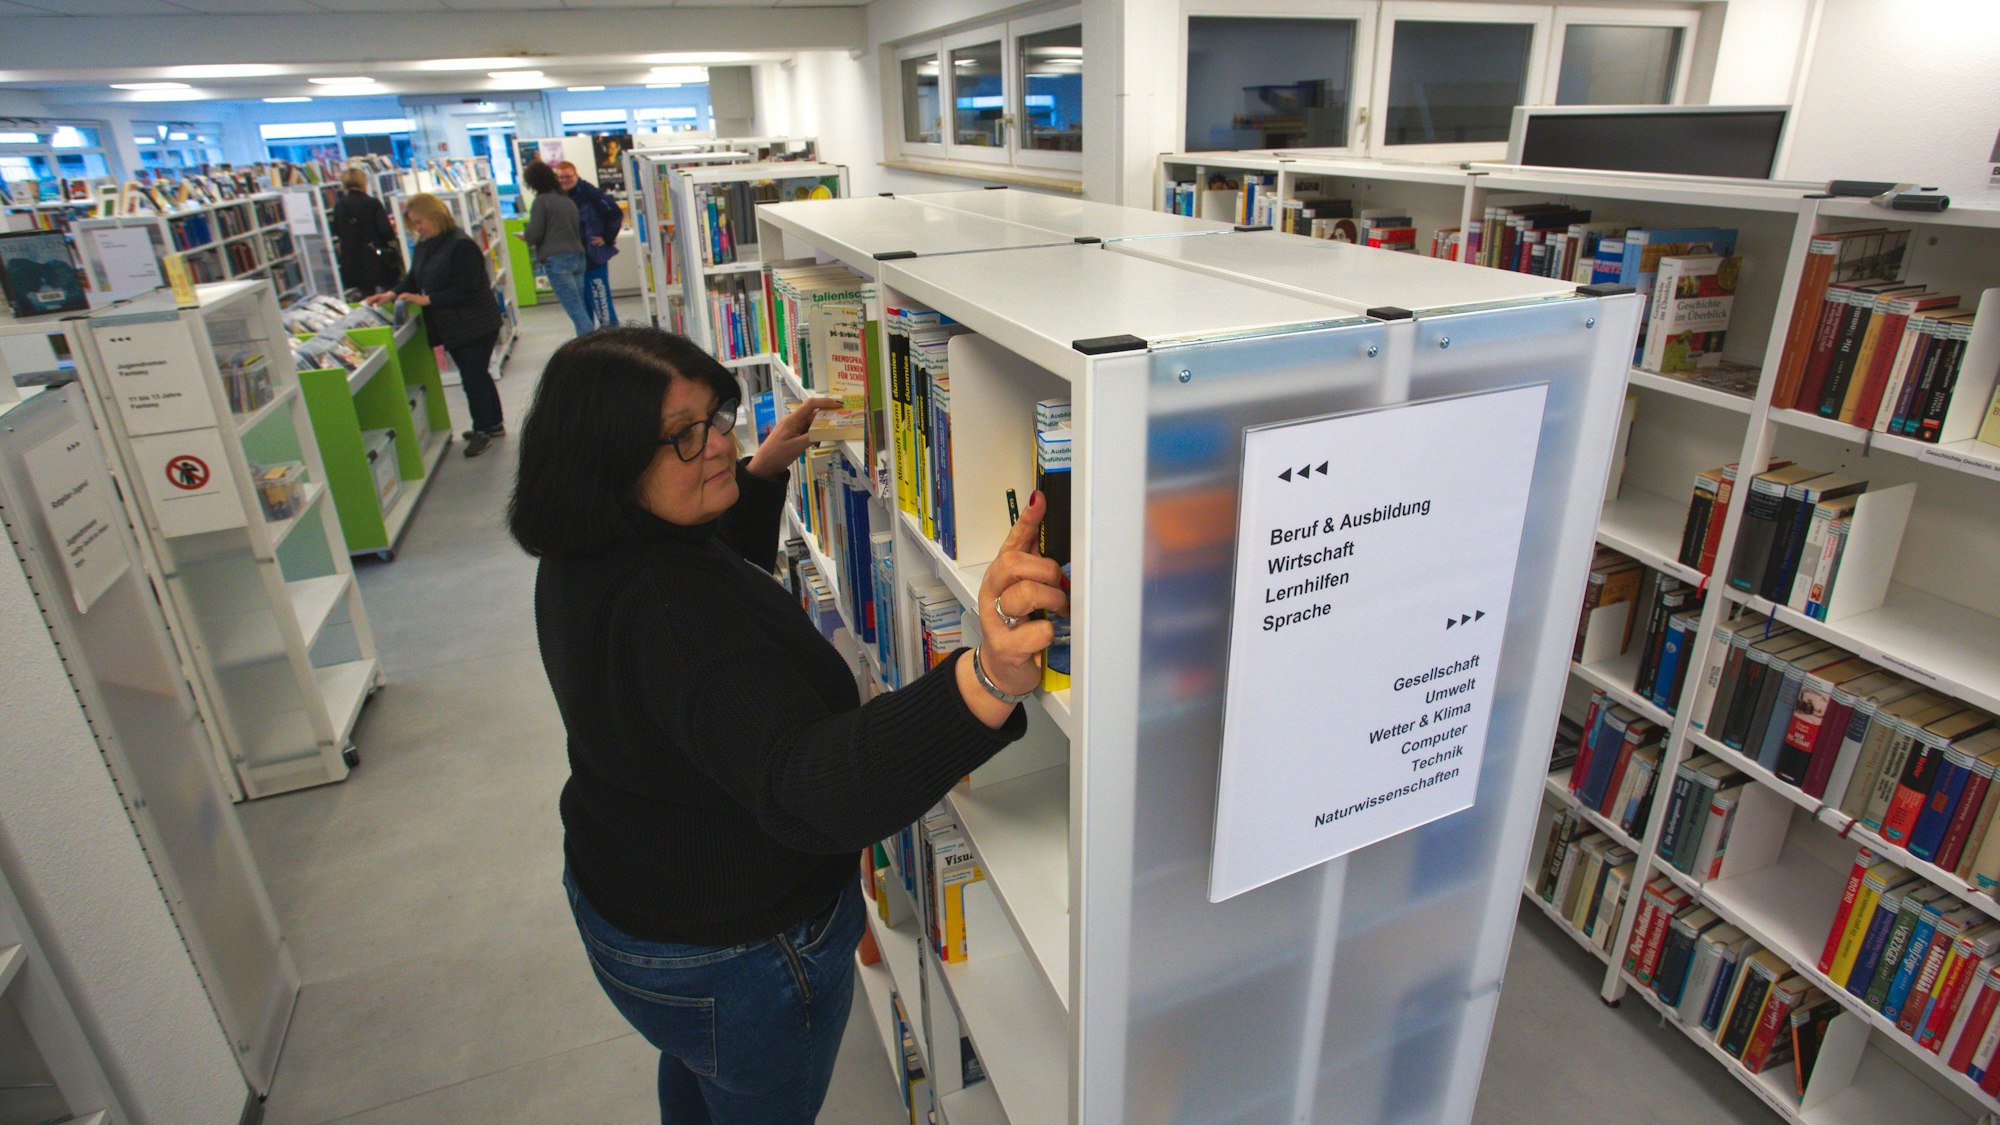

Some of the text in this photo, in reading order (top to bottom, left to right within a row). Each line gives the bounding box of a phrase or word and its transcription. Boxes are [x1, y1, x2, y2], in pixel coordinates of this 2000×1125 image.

[812, 290, 861, 302] talienisc
[1677, 300, 1720, 310] Geschichte
[1688, 308, 1727, 321] Überblick
[832, 354, 863, 364] FREMDSPRA
[1842, 338, 1853, 352] Die
[838, 371, 848, 380] FÜR
[1270, 498, 1432, 546] Beruf & Ausbildung
[1268, 540, 1355, 576] Wirtschaft
[1265, 568, 1350, 604] Lernhilfen
[1262, 601, 1332, 632] Sprache
[1393, 655, 1480, 692] Gesellschaft
[1425, 678, 1476, 704] Umwelt
[1368, 702, 1472, 745] Wetter & Klima
[1400, 723, 1468, 755] Computer
[1412, 744, 1464, 772] Technik
[1314, 766, 1460, 828] Naturwissenschaften
[1844, 876, 1860, 904] DIE DDR
[1630, 937, 1643, 955] Der
[1883, 926, 1910, 966] VIERZIGER
